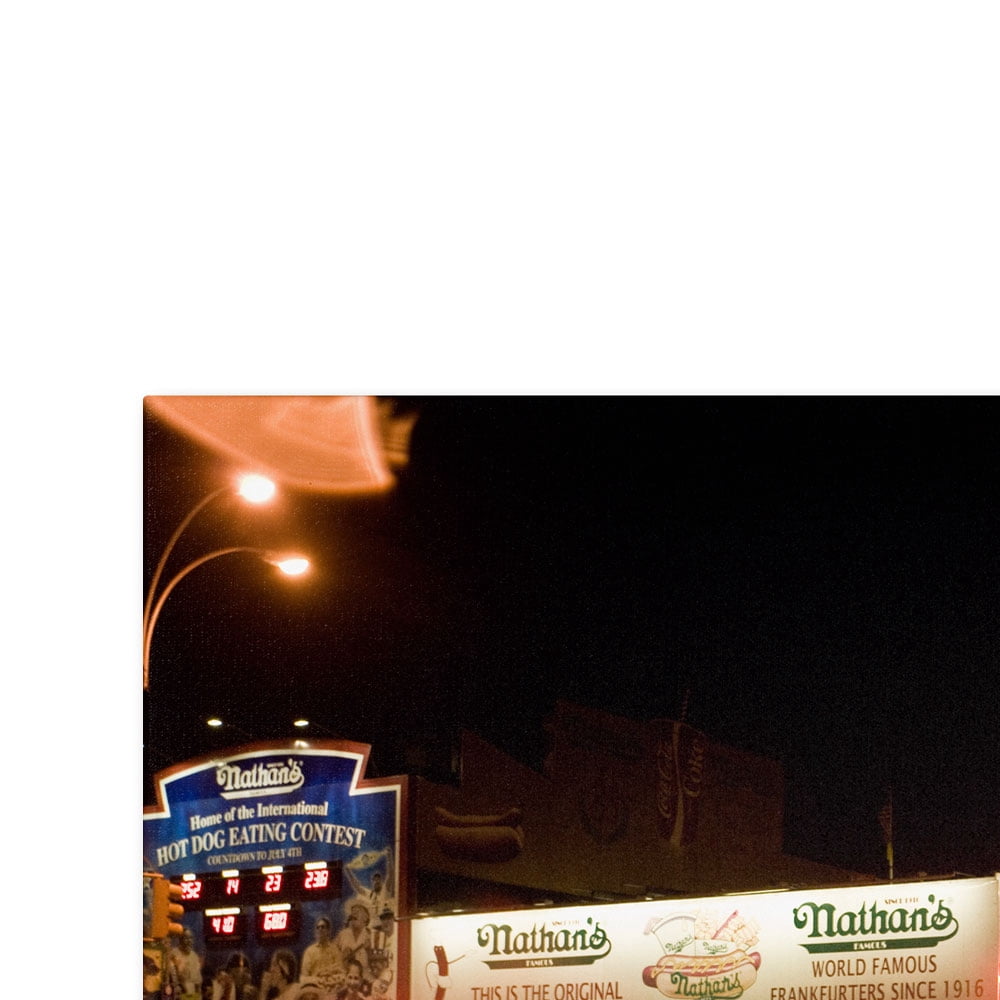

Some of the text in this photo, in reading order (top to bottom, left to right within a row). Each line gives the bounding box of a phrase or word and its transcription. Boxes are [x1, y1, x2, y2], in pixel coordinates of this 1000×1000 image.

[216, 758, 304, 791] Nathan's
[190, 801, 328, 831] Home of the International
[156, 822, 366, 867] HOT DOG EATING CONTEST
[207, 846, 303, 866] COUNTDOWN TO JULY 4TH
[226, 878, 240, 896] 14
[265, 873, 282, 892] 23
[793, 894, 958, 938] Nathan's
[477, 917, 611, 957] Nathan's
[852, 941, 887, 951] FAMOUS
[811, 955, 937, 978] WORLD FAMOUS
[671, 970, 742, 997] Nathan's
[891, 980, 937, 1000] SINCE
[943, 979, 984, 999] 1916
